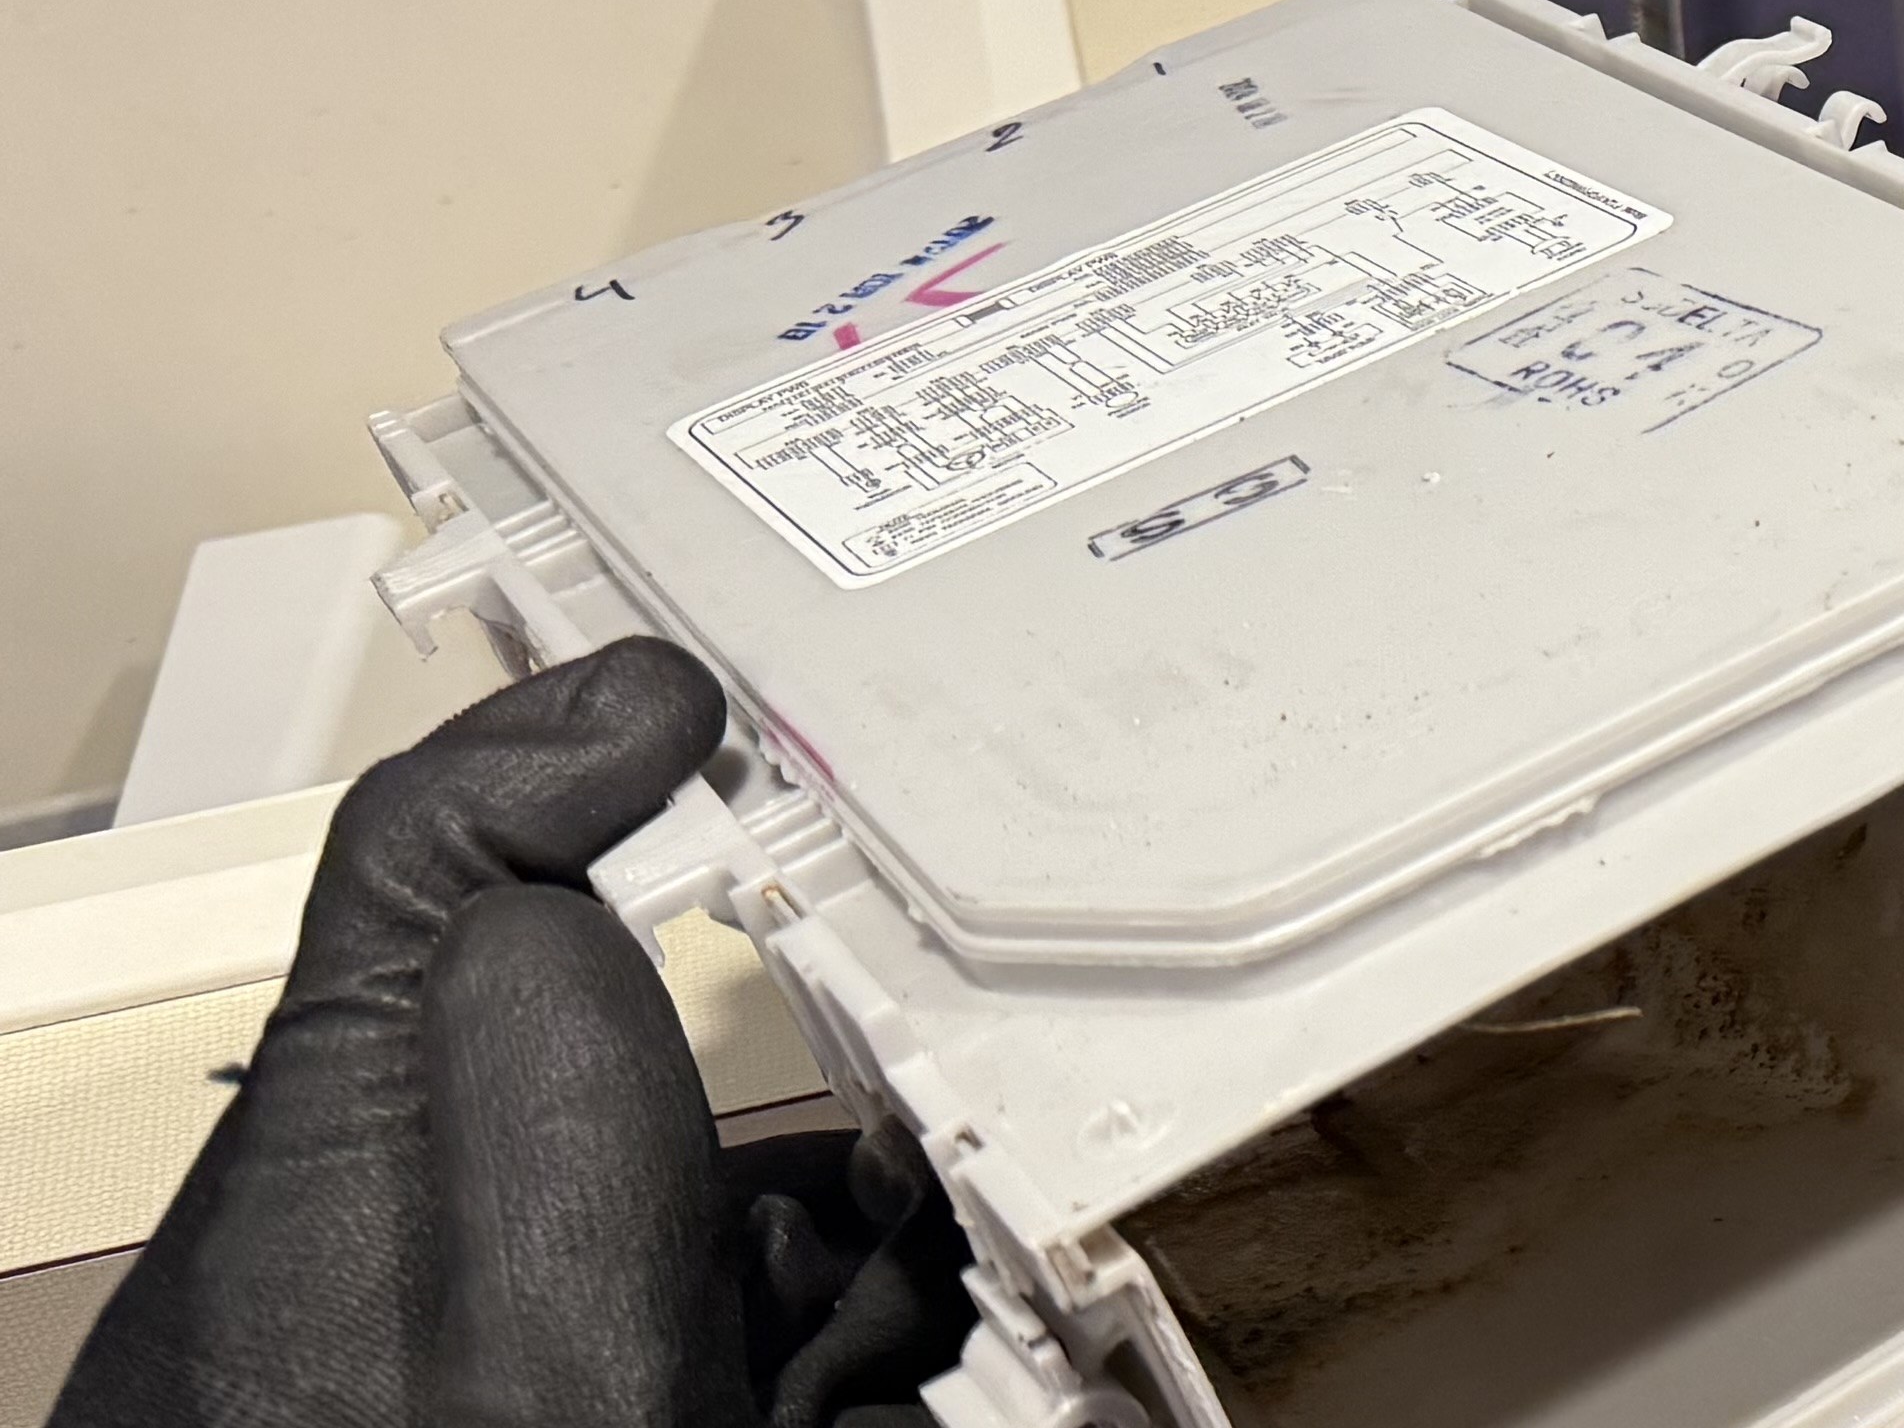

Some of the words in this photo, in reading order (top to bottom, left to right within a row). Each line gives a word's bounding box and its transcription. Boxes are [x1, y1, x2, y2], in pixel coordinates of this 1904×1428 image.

[984, 121, 1024, 152] 2
[764, 208, 806, 242] 3
[573, 278, 637, 302] 4
